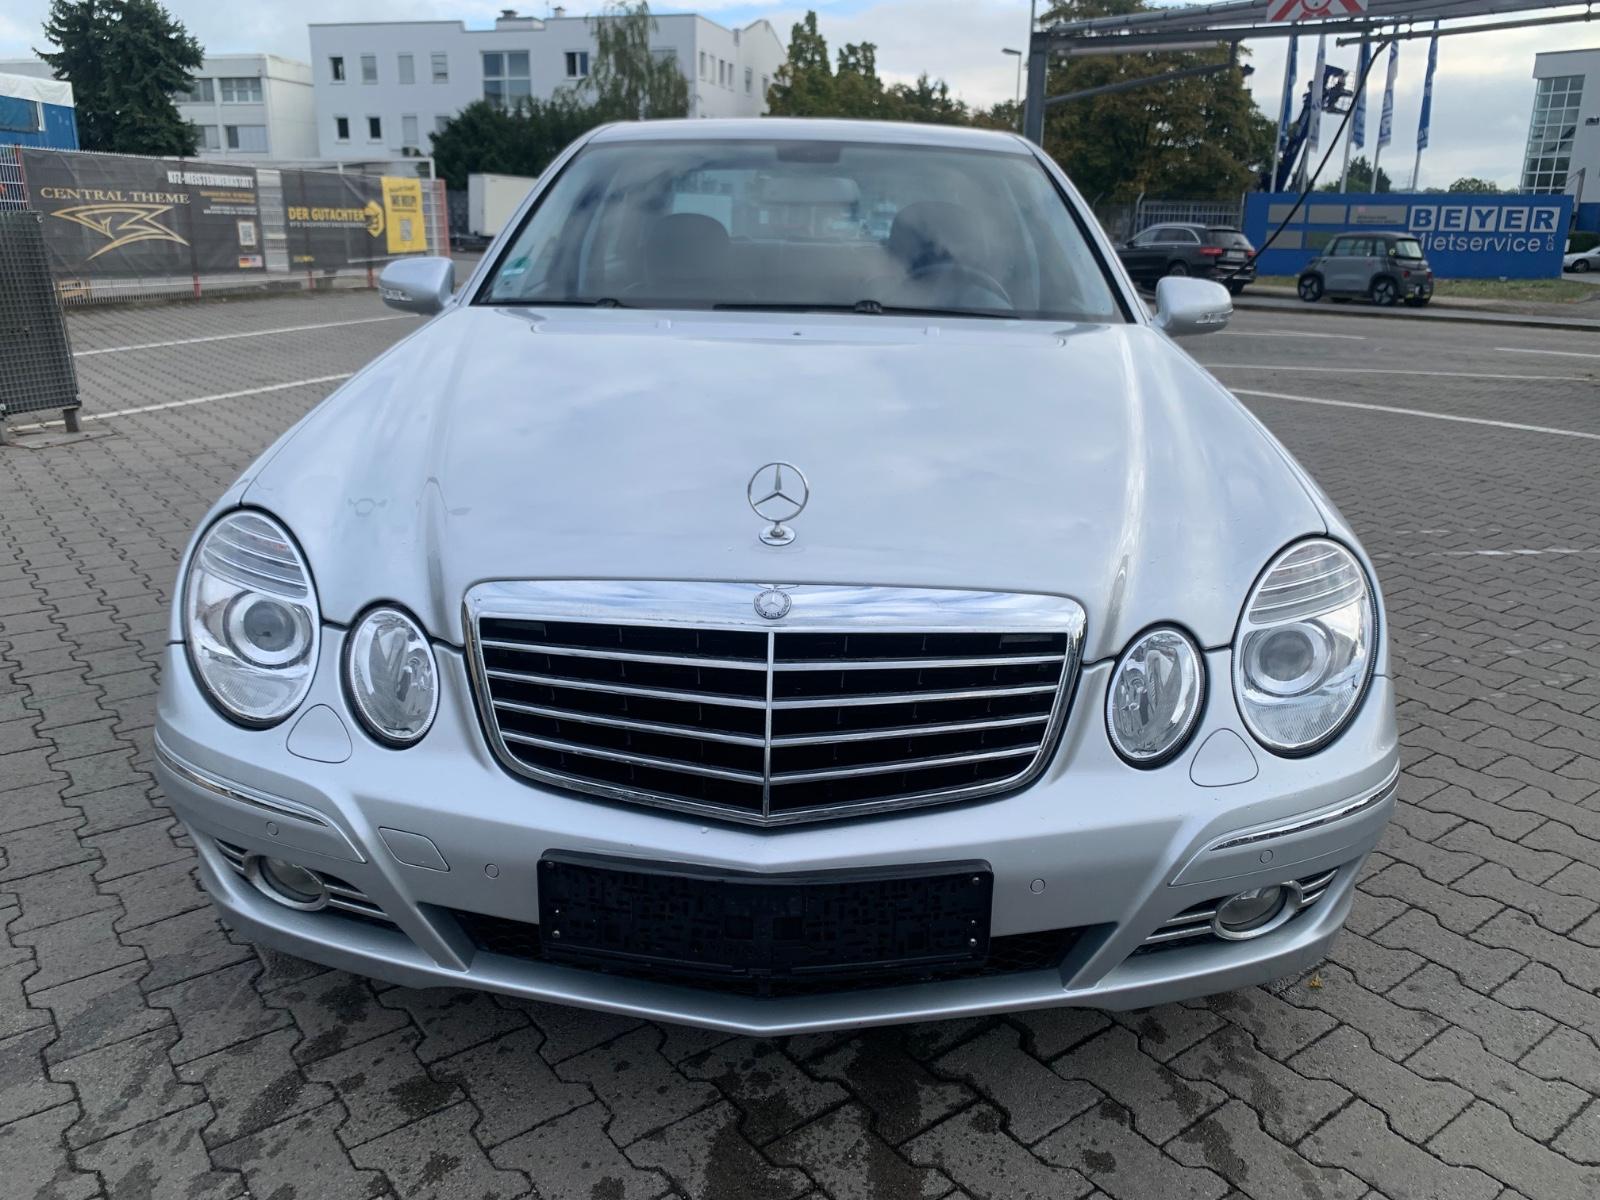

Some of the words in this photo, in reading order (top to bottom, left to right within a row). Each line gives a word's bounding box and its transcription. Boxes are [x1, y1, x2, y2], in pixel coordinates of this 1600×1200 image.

[40, 186, 127, 202] CENTRAL
[128, 191, 191, 204] THEME
[287, 206, 310, 221] DER
[311, 207, 366, 222] GUTACHTER
[1411, 207, 1557, 231] BEYER
